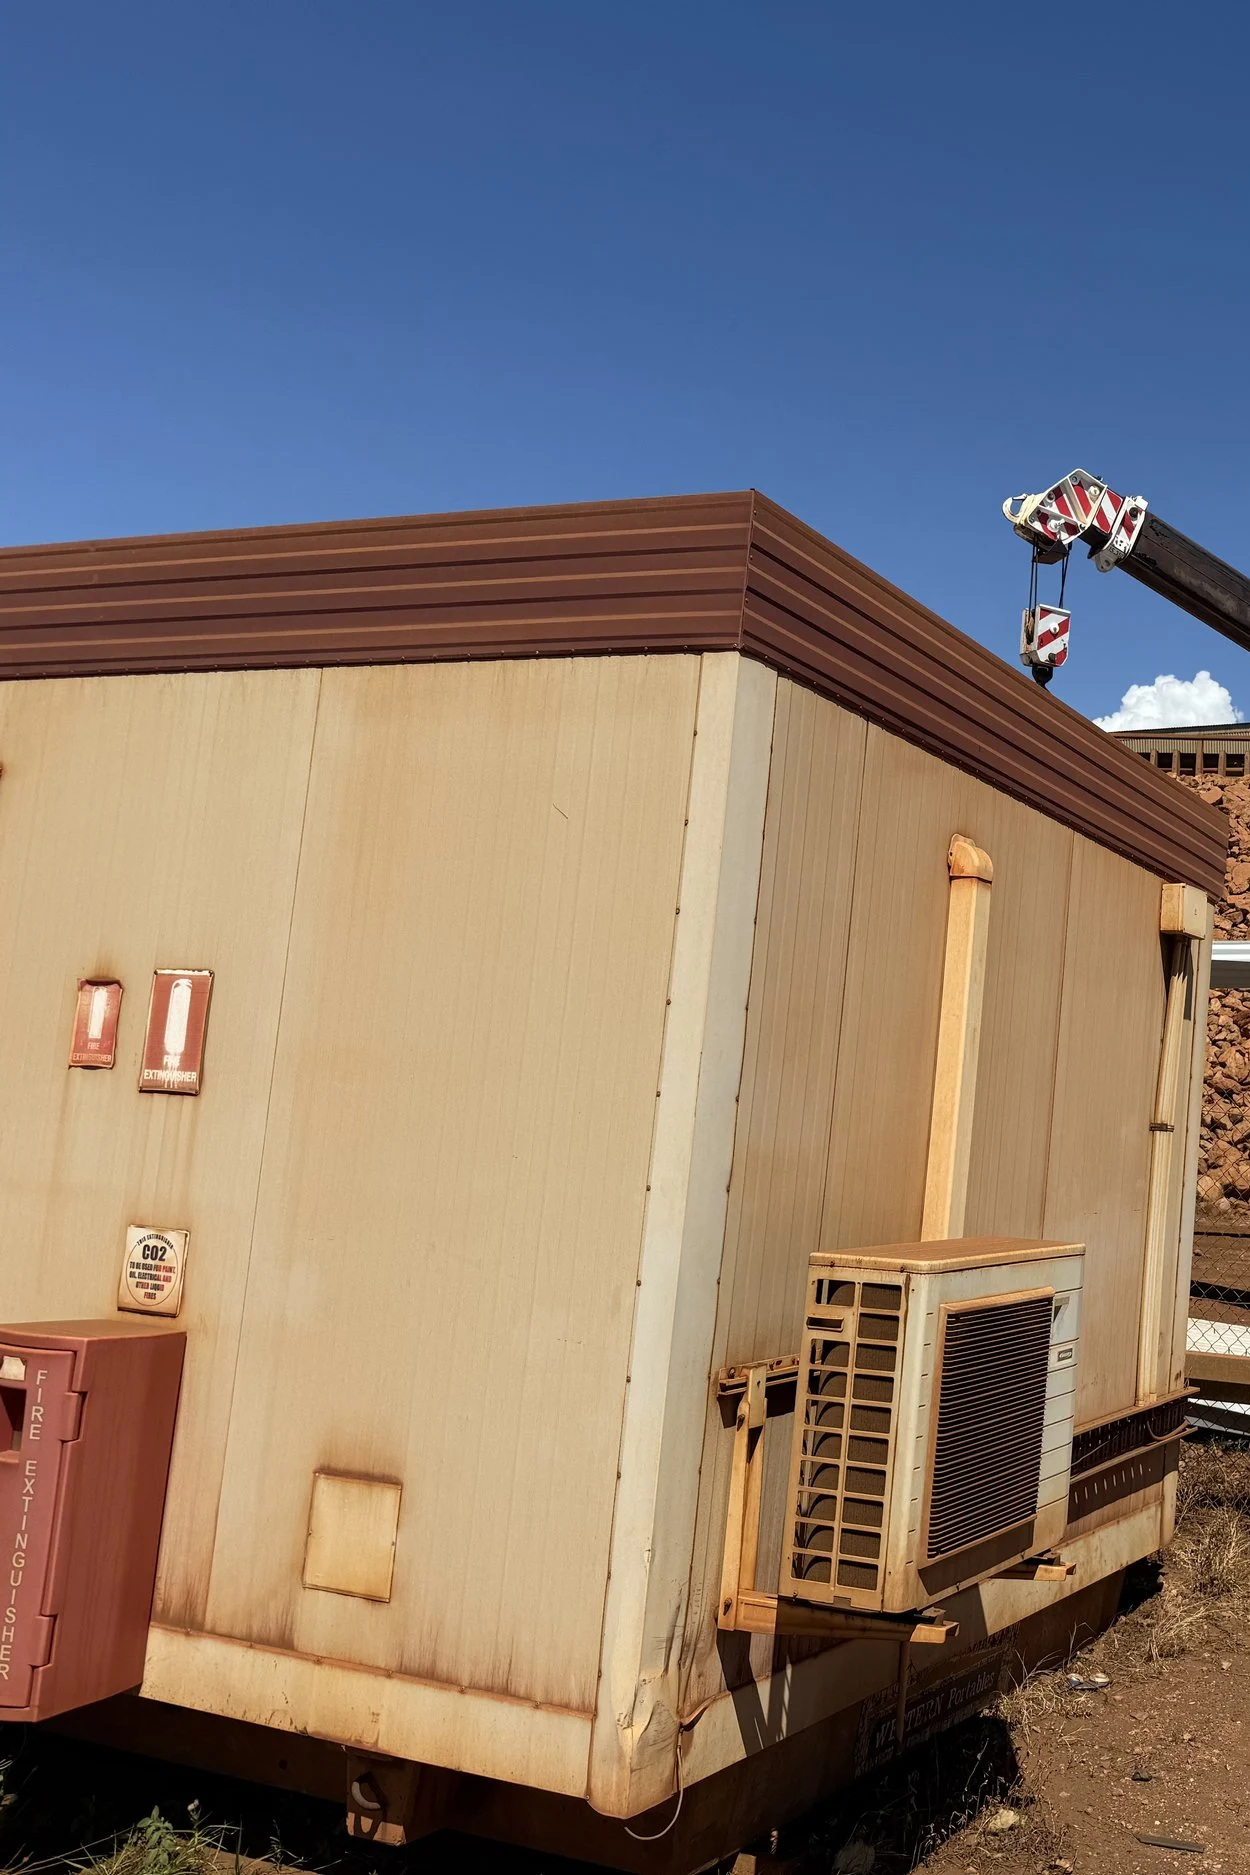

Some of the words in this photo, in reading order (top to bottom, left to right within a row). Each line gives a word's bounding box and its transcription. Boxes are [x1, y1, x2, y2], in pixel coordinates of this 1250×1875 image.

[143, 1069, 197, 1082] EXTINGUISHER
[142, 1244, 167, 1261] CO2
[142, 1263, 153, 1271] USED
[29, 1369, 48, 1440] FIRE
[0, 1460, 37, 1680] EXTINGUISHER
[876, 1693, 945, 1749] WETERN
